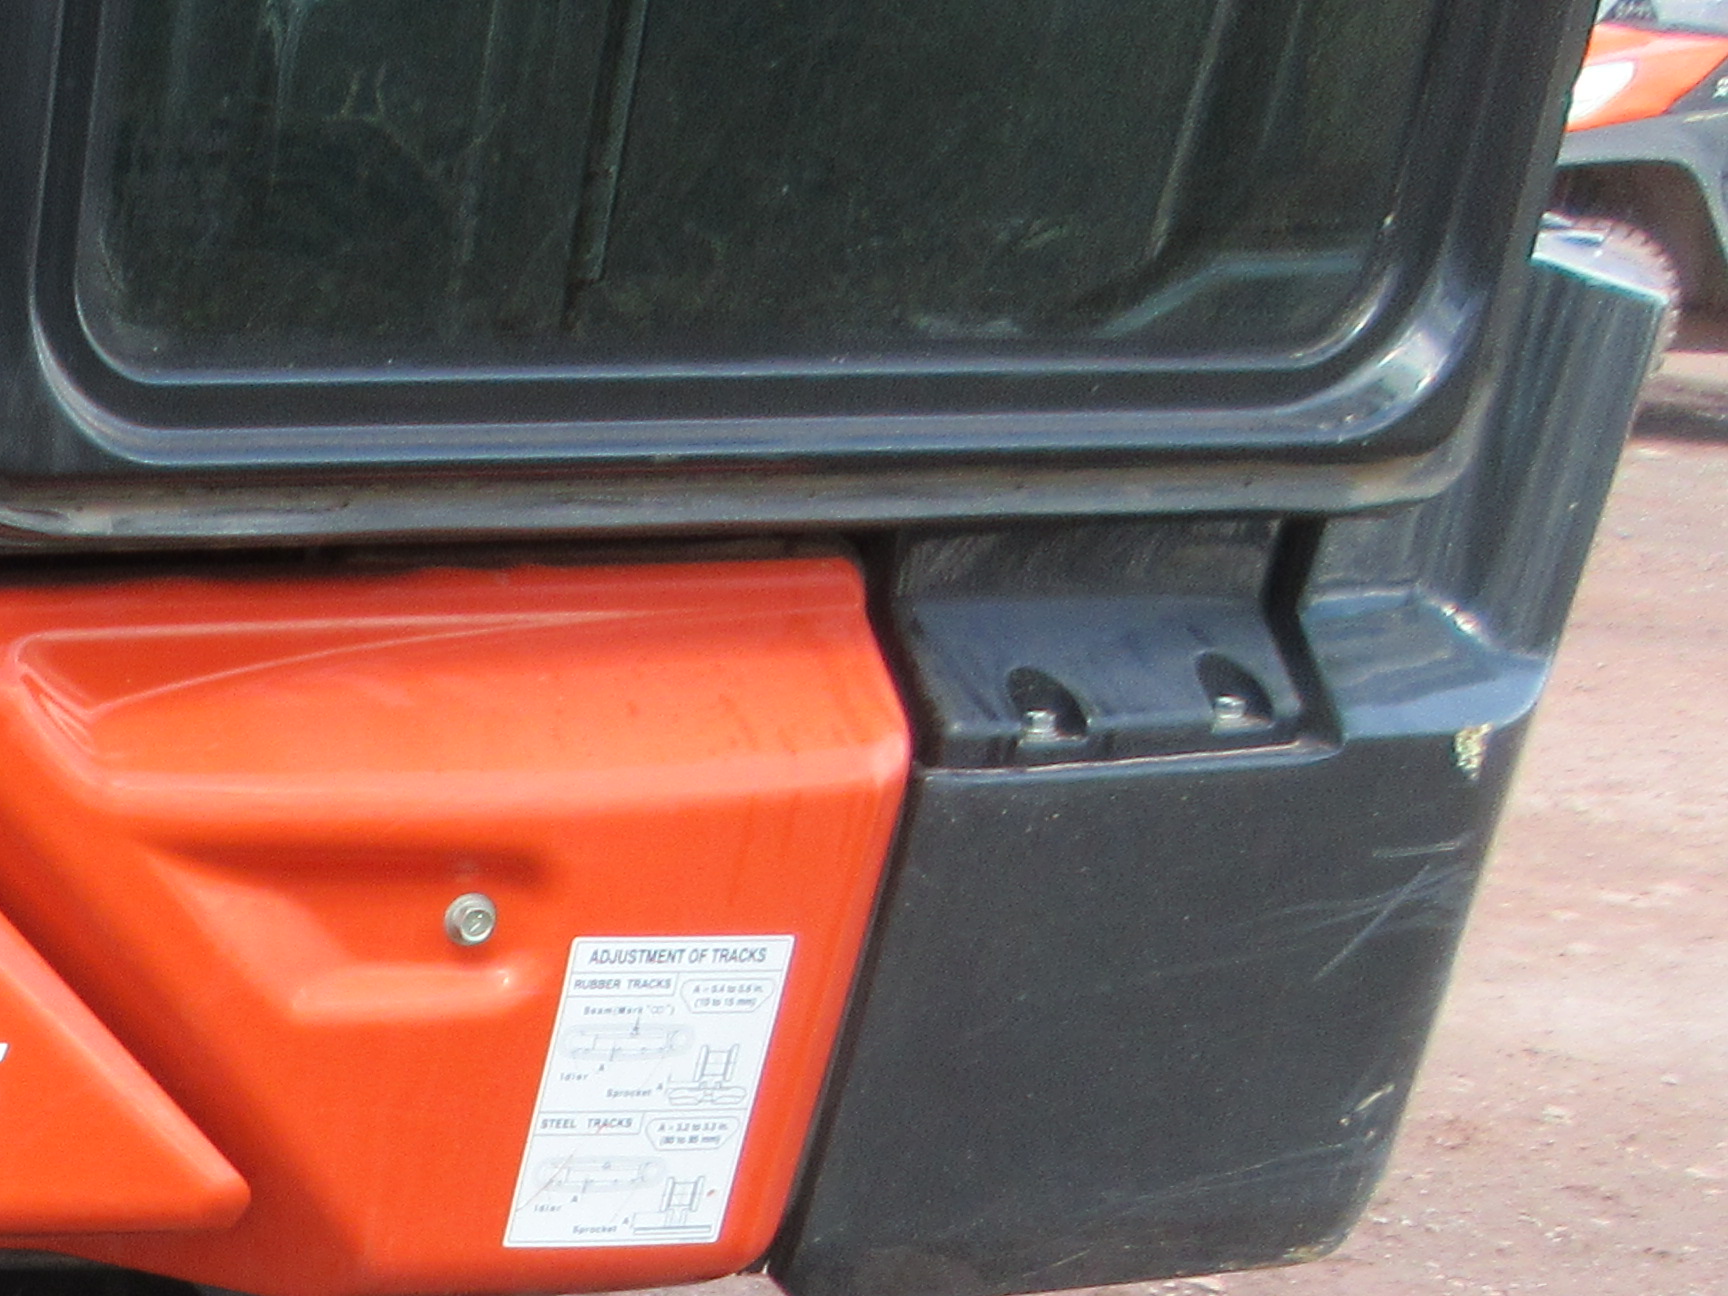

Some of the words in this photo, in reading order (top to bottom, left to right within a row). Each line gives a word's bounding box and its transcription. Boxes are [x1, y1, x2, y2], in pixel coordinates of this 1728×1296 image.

[589, 948, 685, 965] ADJUSTMENT
[688, 948, 710, 964] OF
[711, 947, 767, 963] TRACKS
[573, 979, 621, 990] RUBBER
[627, 978, 672, 989] TRACKS
[560, 1072, 589, 1081] Idler
[606, 1087, 652, 1098] Sprocket
[540, 1118, 576, 1129] STEEL
[587, 1118, 633, 1129] TRACKS
[572, 1225, 617, 1235] Sprocket
